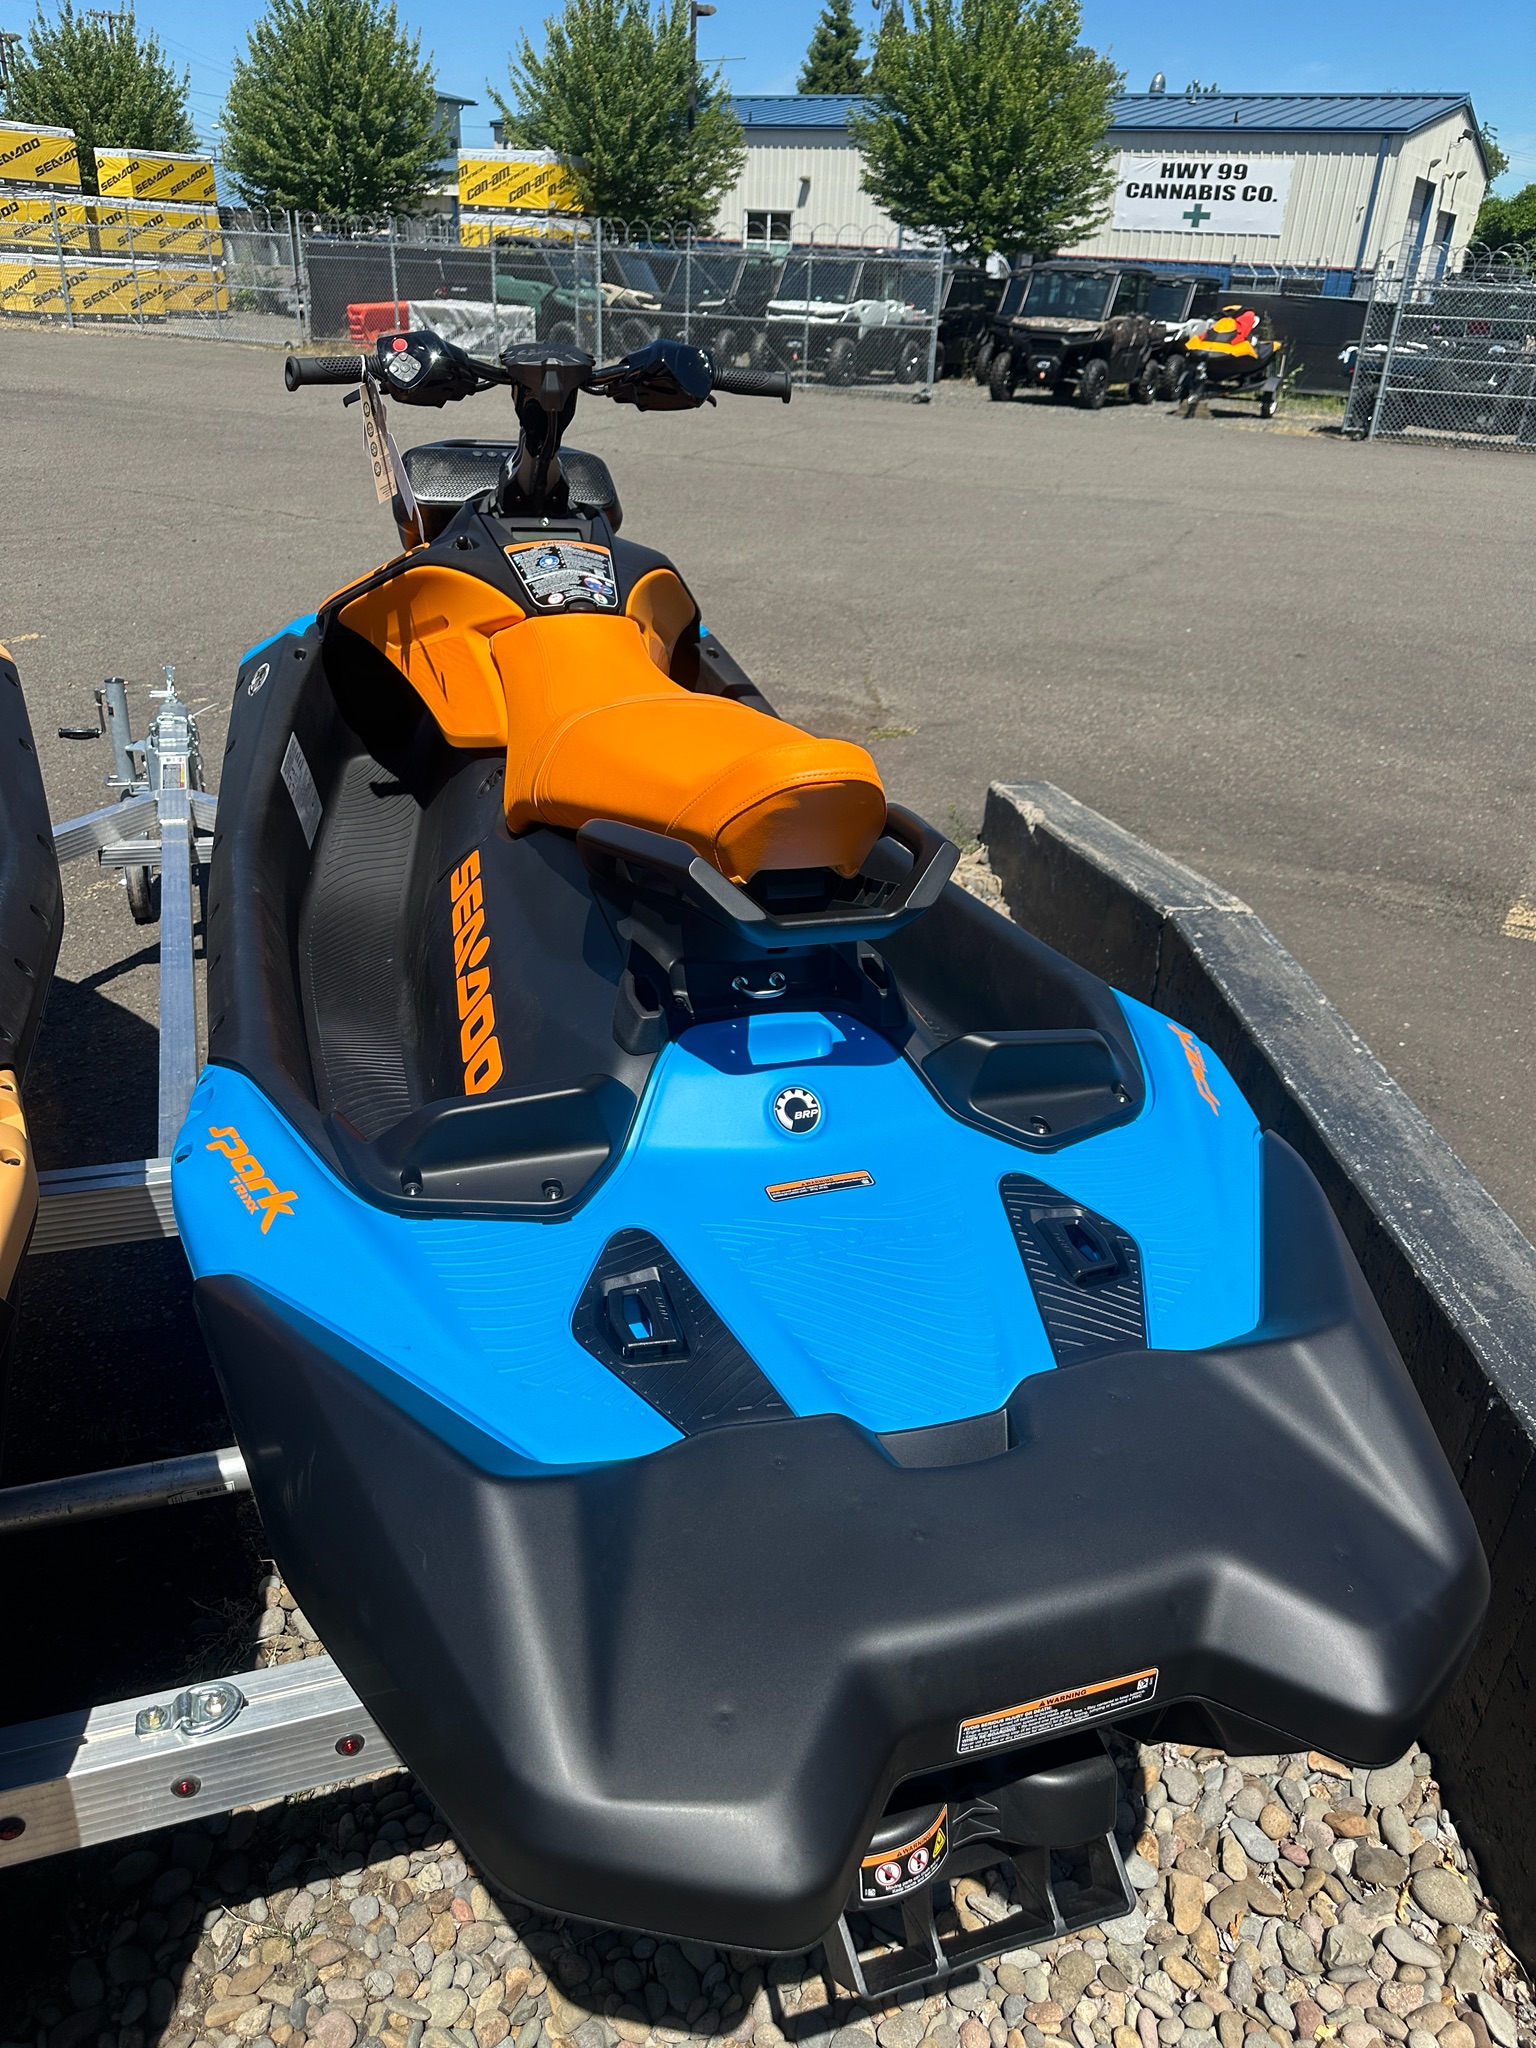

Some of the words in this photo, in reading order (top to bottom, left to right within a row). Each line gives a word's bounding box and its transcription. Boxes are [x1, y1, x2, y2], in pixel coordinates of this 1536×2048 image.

[1160, 162, 1213, 179] HWY
[1218, 163, 1248, 180] 99
[467, 166, 510, 201] can-am
[1126, 182, 1236, 200] CANNABIS
[1242, 185, 1278, 202] CO.
[794, 1108, 818, 1120] BRP
[229, 1175, 259, 1215] TRIXX
[1046, 1689, 1086, 1704] WARNING
